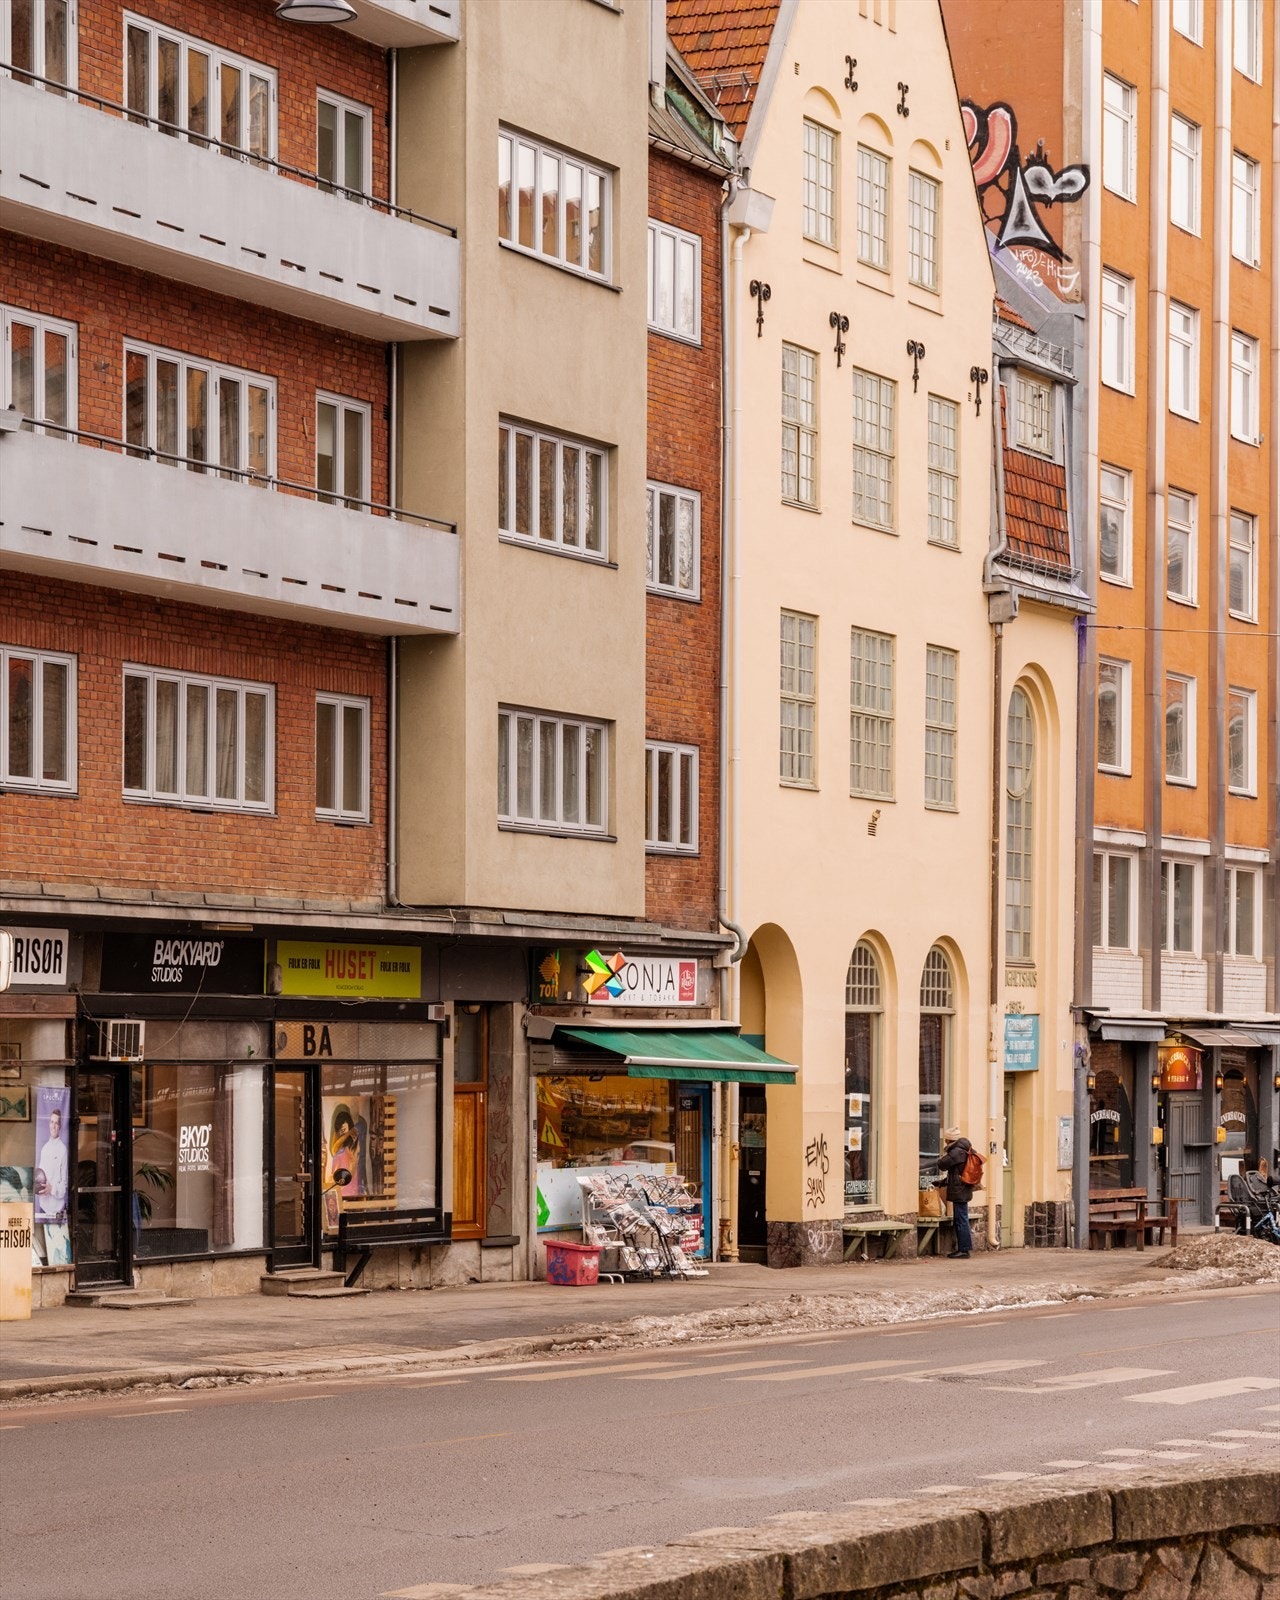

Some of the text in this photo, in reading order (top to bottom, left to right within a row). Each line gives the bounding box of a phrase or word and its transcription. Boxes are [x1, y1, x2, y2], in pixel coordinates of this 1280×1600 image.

[12, 937, 63, 974] RISØR
[288, 958, 320, 969] FOLK ER FOLK
[325, 949, 377, 979] HUSET
[380, 961, 410, 972] FOLK ER FOLK
[151, 967, 183, 982] STUDIOS
[616, 962, 676, 993] ONJA
[303, 1025, 333, 1056] BA
[179, 1125, 210, 1148] BKYD
[178, 1148, 209, 1163] STUDIOS
